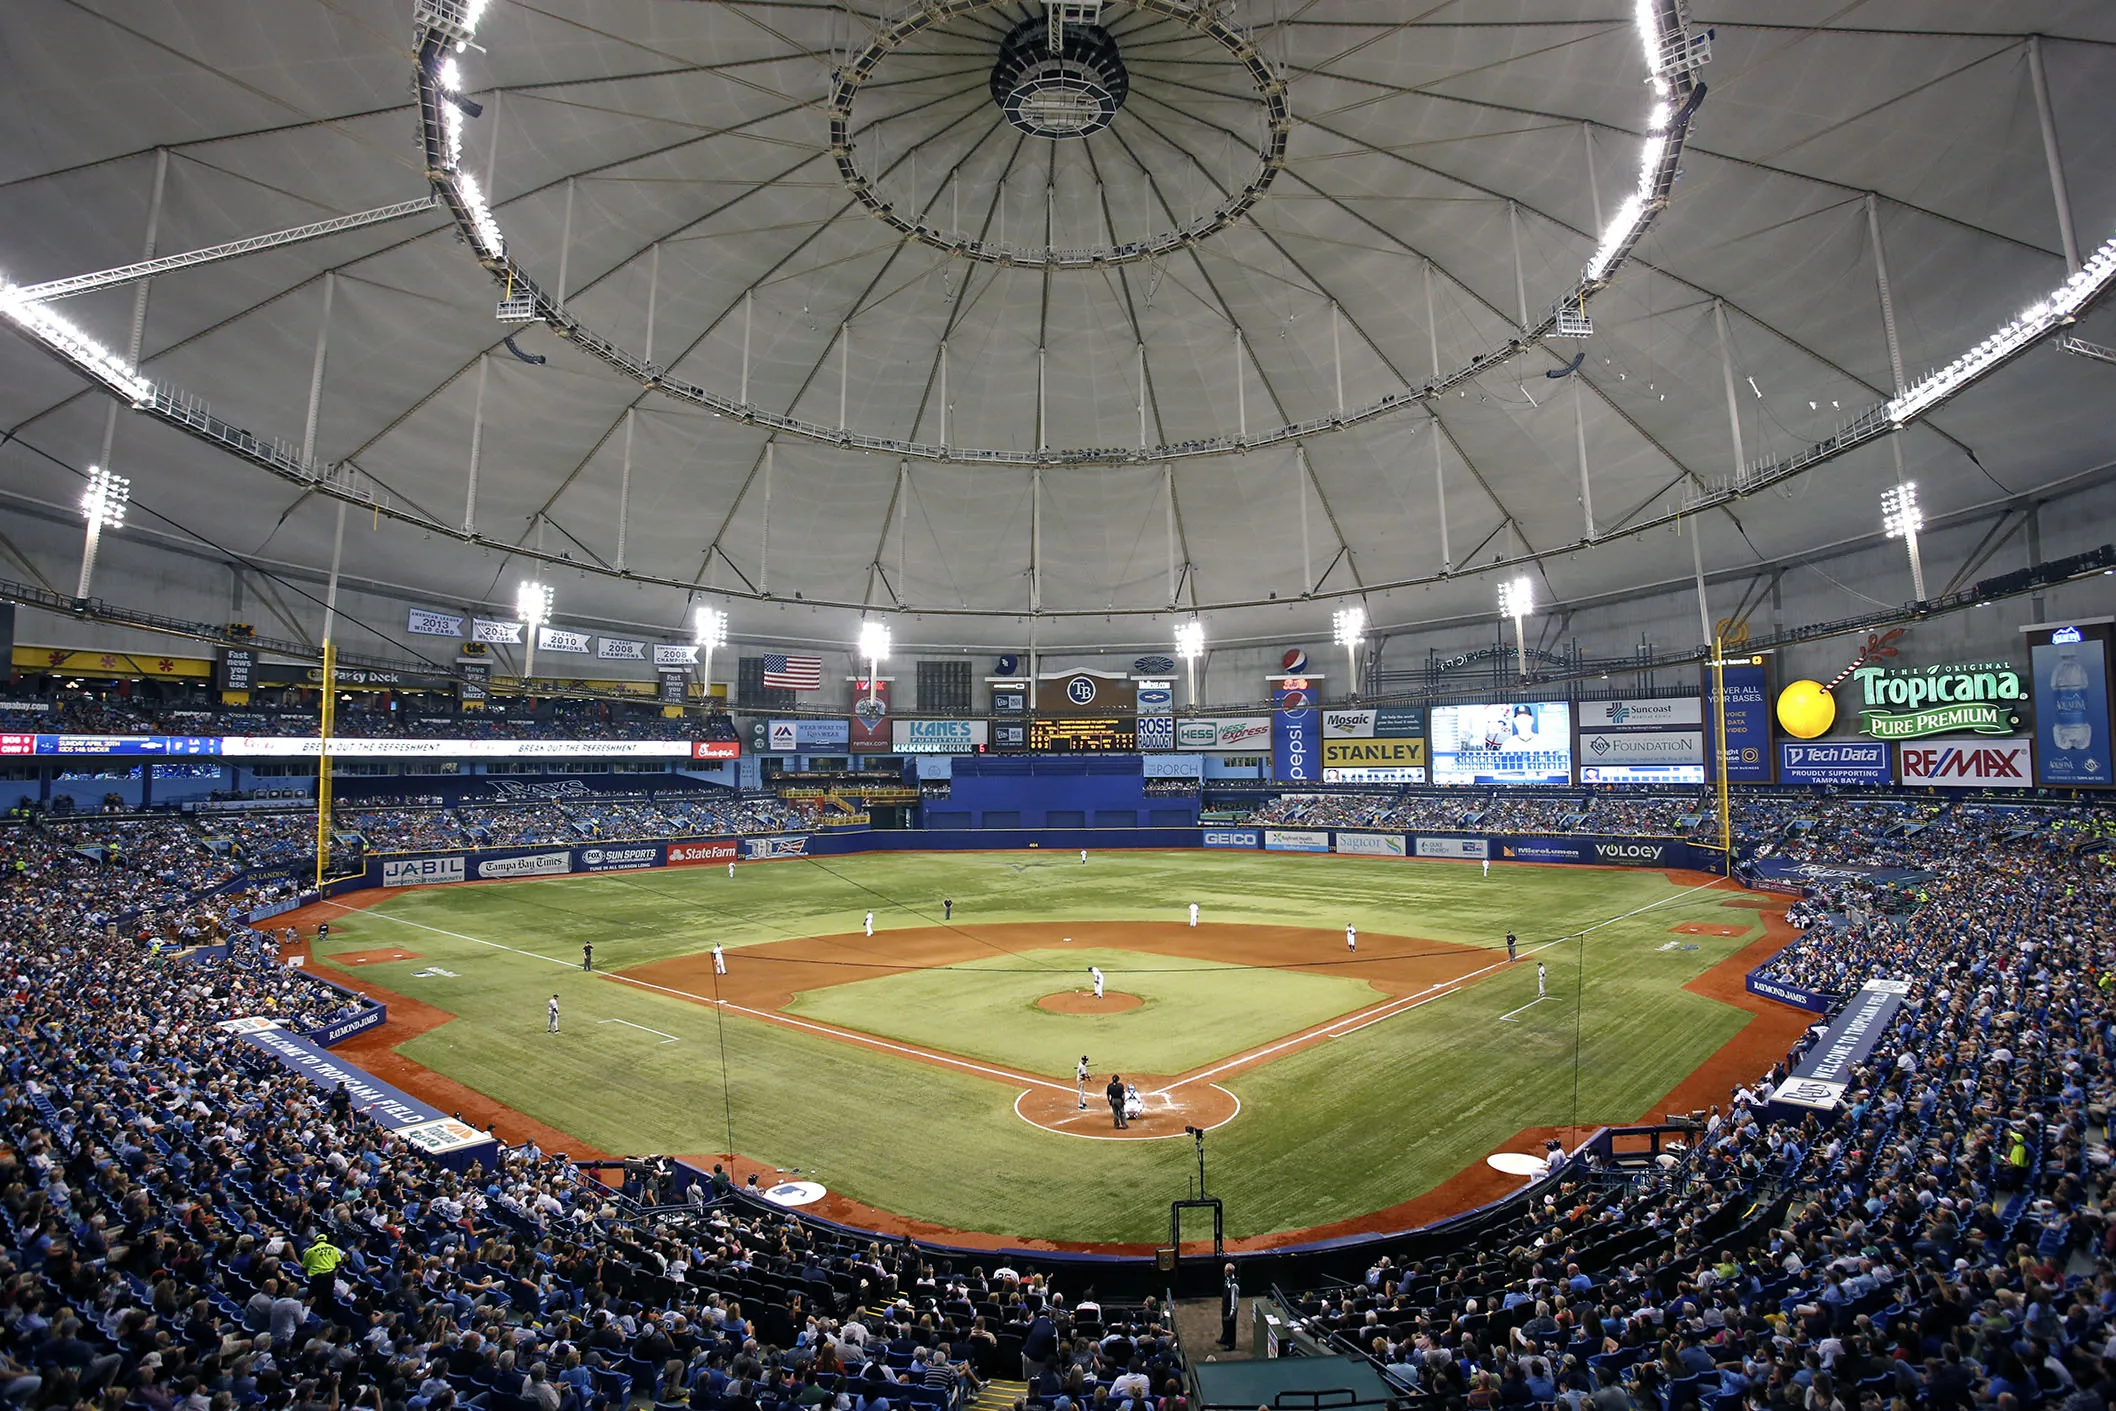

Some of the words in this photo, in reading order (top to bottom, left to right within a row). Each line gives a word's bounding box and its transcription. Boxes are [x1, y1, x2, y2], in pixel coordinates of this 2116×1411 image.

[423, 618, 449, 629] 2013
[551, 636, 577, 645] 2010
[542, 643, 583, 652] CHAMPIONS
[608, 644, 633, 653] 2008
[228, 650, 249, 659] Fast
[664, 650, 687, 659] 2008
[230, 667, 248, 675] you
[1945, 662, 2011, 673] ORIGINAL
[369, 672, 399, 683] Deck
[1072, 682, 1092, 699] TB
[1743, 686, 1759, 694] ALL
[1853, 667, 2021, 708] Tropicana
[1708, 694, 1731, 703] YOR
[1732, 694, 1763, 702] BASES.
[1631, 705, 1672, 714] Suncoast
[1328, 713, 1369, 725] Mosaic
[1871, 718, 1914, 735] PURE
[1916, 708, 1999, 726] PREMIUM
[910, 721, 971, 736] KANE'S
[1138, 718, 1172, 734] ROSE
[1218, 723, 1247, 733] HESS
[1181, 729, 1213, 739] HESS
[1138, 734, 1172, 748] RADIOLOGY
[1613, 739, 1693, 751] FOUNDATION
[302, 743, 332, 751] BREK
[336, 743, 353, 751] OUT
[358, 743, 373, 751] THE
[378, 743, 440, 752] REFRESHMENT
[1286, 725, 1307, 779] pepsi
[1327, 744, 1420, 760] STANLEY
[1806, 747, 1840, 761] Tech
[1841, 747, 1878, 761] Data
[1902, 747, 2023, 778] RE/MAX
[1157, 763, 1198, 775] PORCH
[1828, 769, 1879, 777] SUPPORTING
[1204, 832, 1257, 845] GEICO
[1339, 835, 1382, 849] Sagicor
[606, 850, 623, 860] SUN
[623, 849, 656, 859] SPORTS
[685, 848, 712, 860] State
[712, 846, 736, 857] Farm
[1518, 847, 1579, 855] MicroLumen
[1595, 844, 1663, 860] VOLOGY
[386, 860, 463, 877] JABIL
[485, 862, 516, 873] Tampa
[518, 860, 535, 870] Bay
[537, 856, 562, 867] Times
[258, 870, 290, 880] LANDING
[386, 878, 414, 886] SUPPORTS
[427, 875, 463, 883] COMMUNITY
[1753, 981, 1785, 998] RAYMOND
[1785, 990, 1807, 1005] JAMES
[329, 1020, 361, 1041] RAYMOND
[358, 1013, 379, 1030] JAMES
[1810, 1045, 1855, 1079] WELCOME
[1836, 1035, 1860, 1045] TO
[253, 1031, 305, 1061] WELCOME
[296, 1051, 319, 1065] TO
[309, 1062, 381, 1101] TROPICANA
[373, 1098, 425, 1124] FIELD
